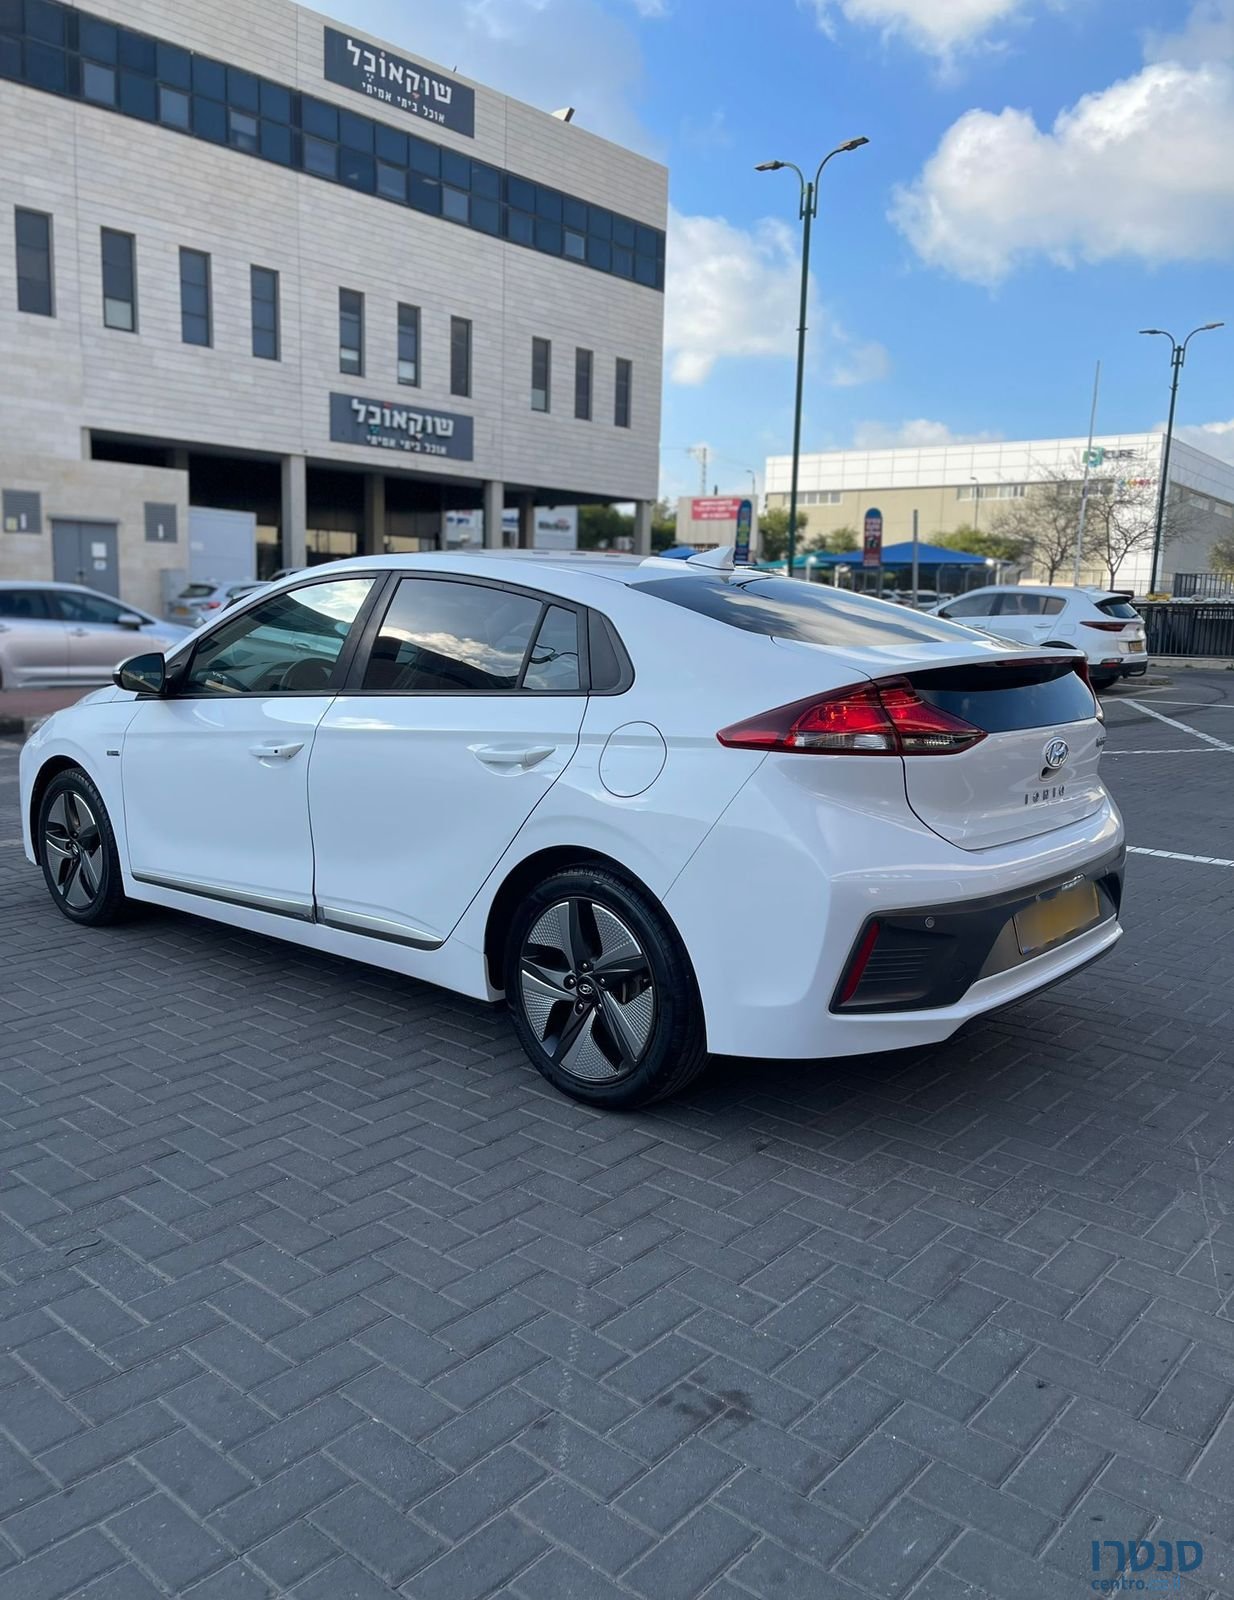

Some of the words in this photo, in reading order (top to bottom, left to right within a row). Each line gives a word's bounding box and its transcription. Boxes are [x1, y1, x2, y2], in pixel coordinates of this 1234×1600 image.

[362, 82, 392, 102] אמיתי
[396, 96, 418, 113] ביתי
[422, 105, 445, 124] אוכל
